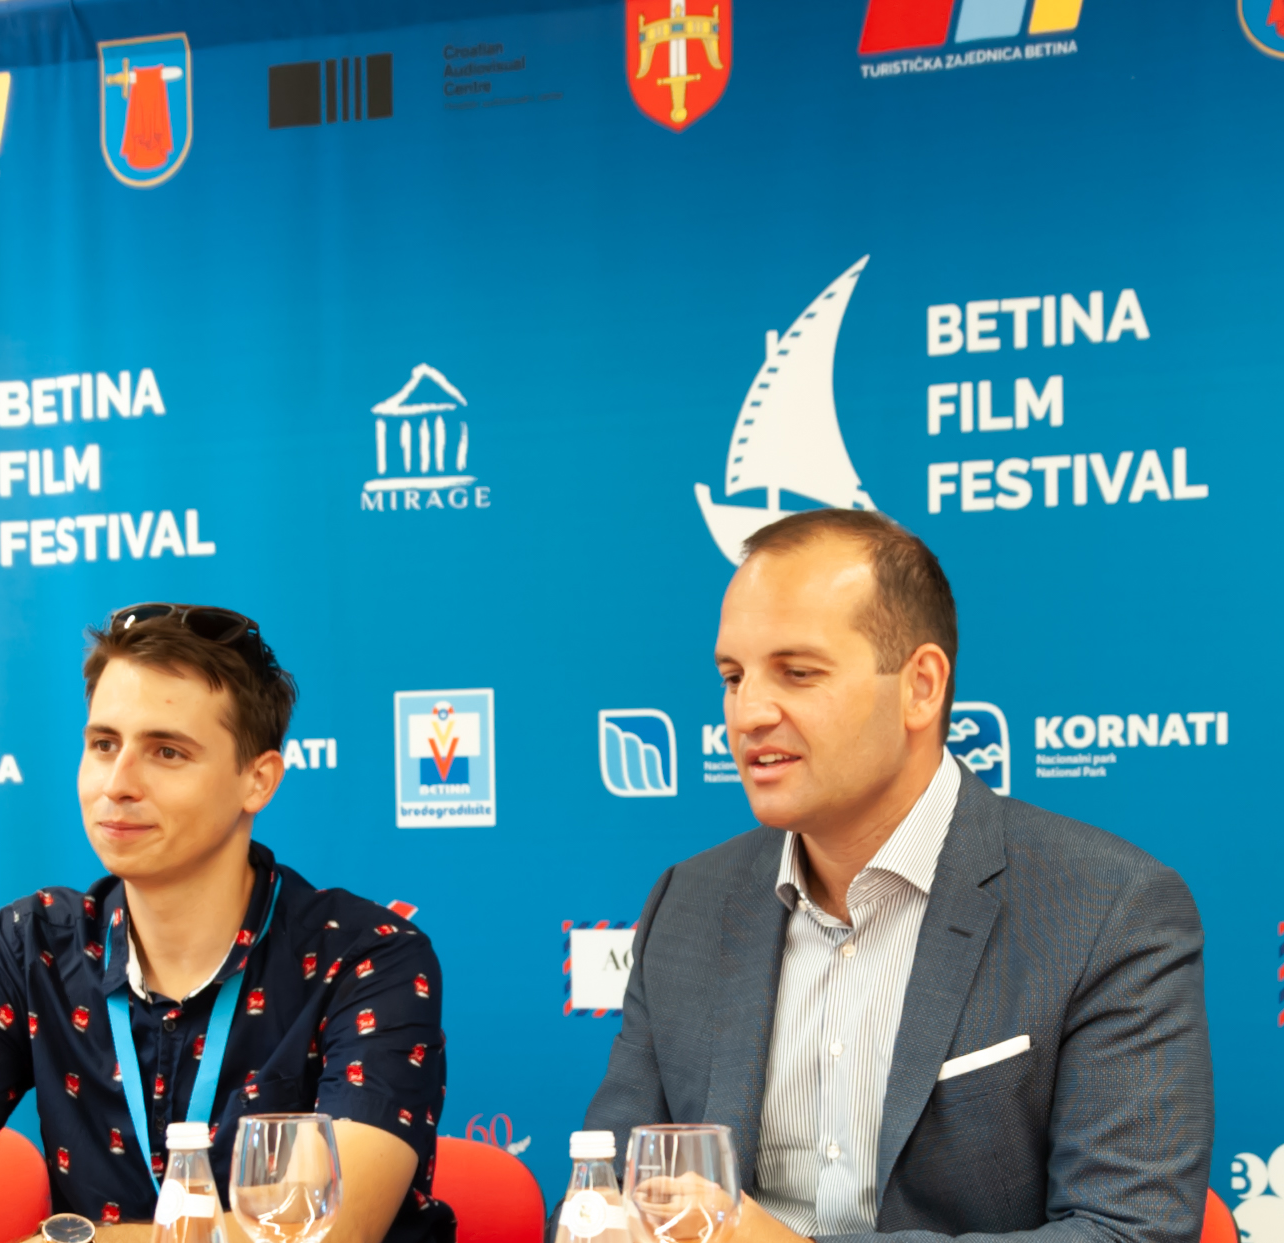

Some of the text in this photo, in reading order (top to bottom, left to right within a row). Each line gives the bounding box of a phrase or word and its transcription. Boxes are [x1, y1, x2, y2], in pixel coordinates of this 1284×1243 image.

[861, 39, 1078, 78] TURISTIČKA ZAJEDNICA BETINA
[926, 289, 1151, 357] BETINA
[927, 375, 1065, 436] FILM
[360, 486, 493, 513] MIRAGE
[927, 448, 1210, 516] FESTIVAL
[0, 509, 217, 568] FESTIVAL
[702, 724, 733, 756] K
[1035, 711, 1229, 750] KORNATI
[1036, 752, 1117, 766] Nacionalni park
[1036, 766, 1107, 778] National Park
[419, 783, 471, 797] BETINA
[465, 1112, 514, 1151] 60
